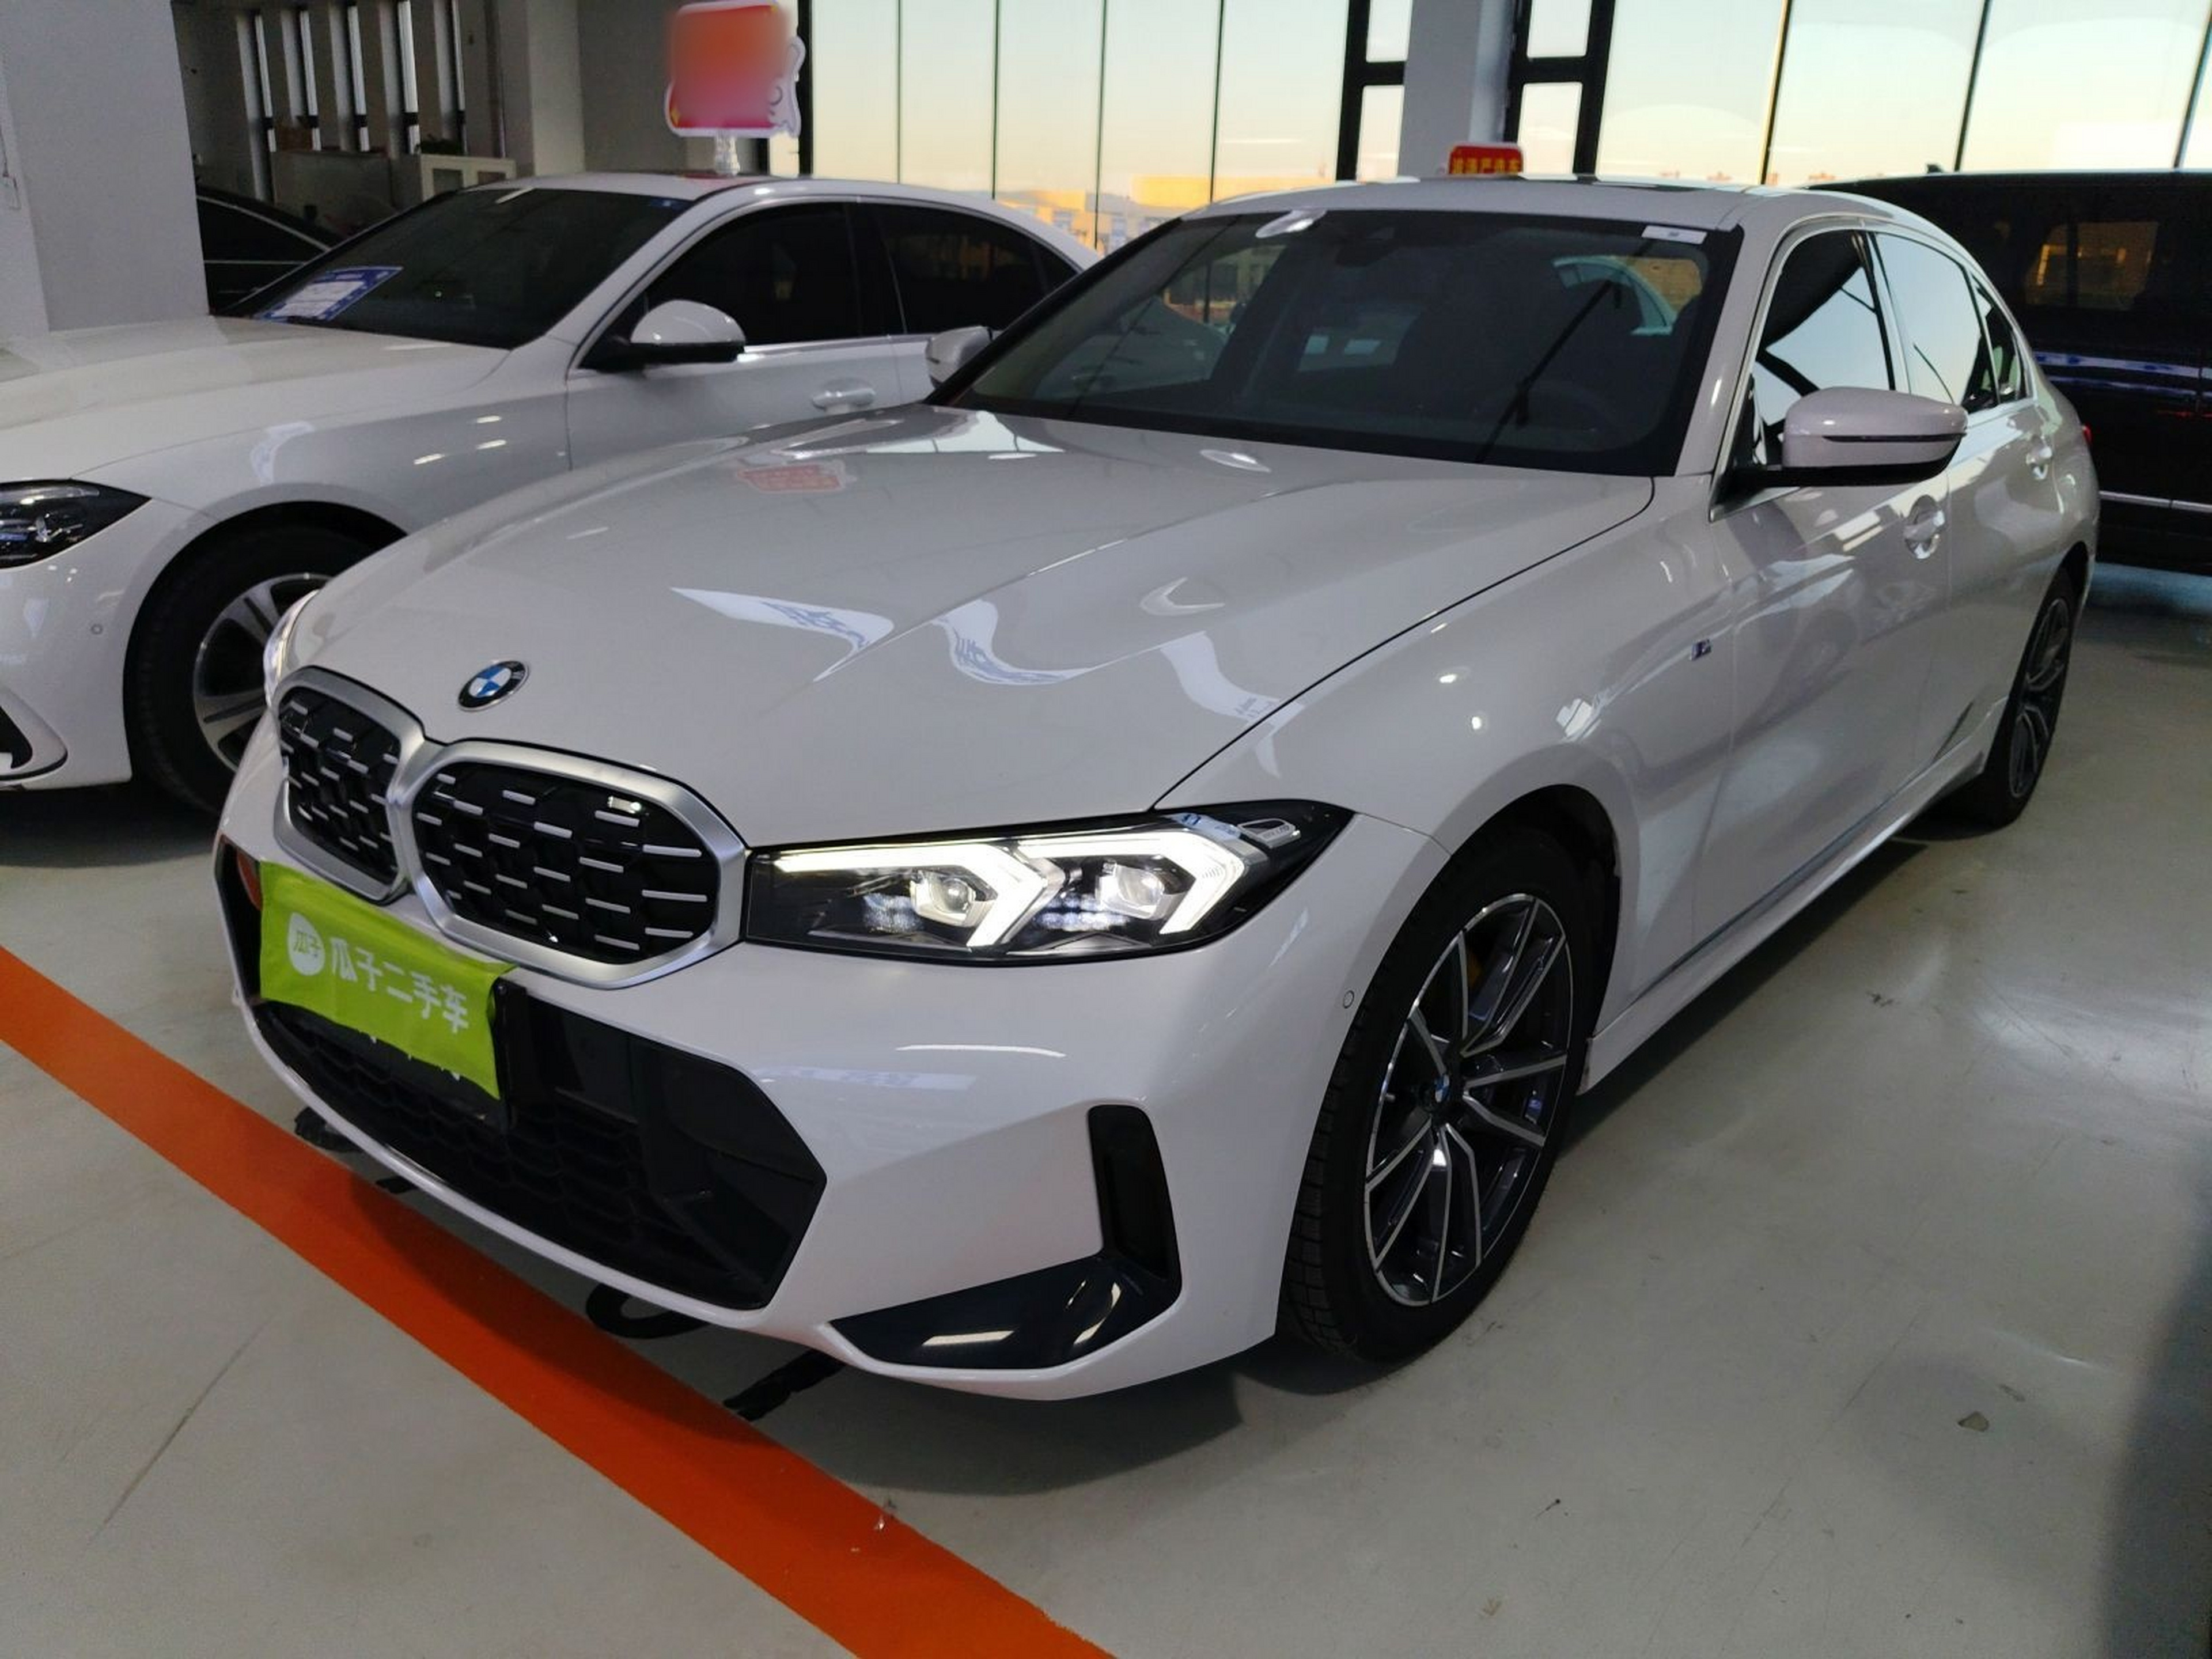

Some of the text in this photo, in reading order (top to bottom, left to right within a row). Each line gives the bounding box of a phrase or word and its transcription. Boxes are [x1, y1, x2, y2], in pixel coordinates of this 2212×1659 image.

[331, 937, 469, 1034] 瓜子二手车
